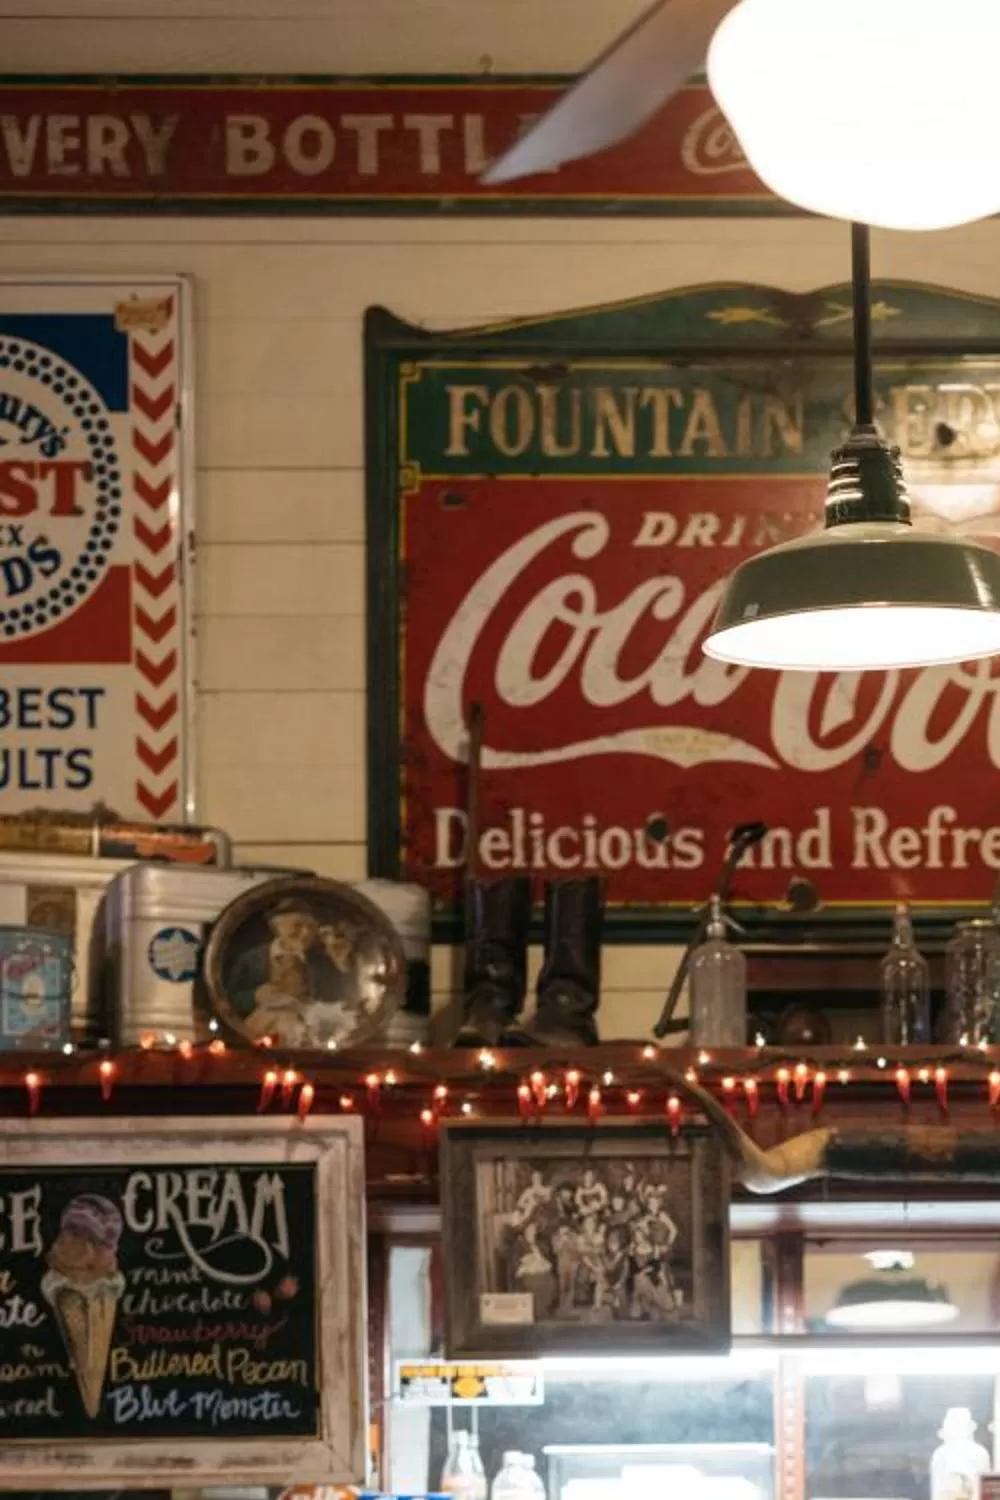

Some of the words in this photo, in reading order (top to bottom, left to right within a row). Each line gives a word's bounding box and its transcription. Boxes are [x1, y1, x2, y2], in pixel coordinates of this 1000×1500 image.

[0, 114, 176, 176] VERY
[225, 113, 500, 177] BOTTL
[443, 383, 801, 458] FOUNTAIN
[434, 806, 704, 870] Delicious
[121, 1167, 291, 1284] CREAM
[110, 1347, 225, 1383] Buttered
[226, 1347, 309, 1387] Pecan
[194, 1389, 302, 1426] Monster
